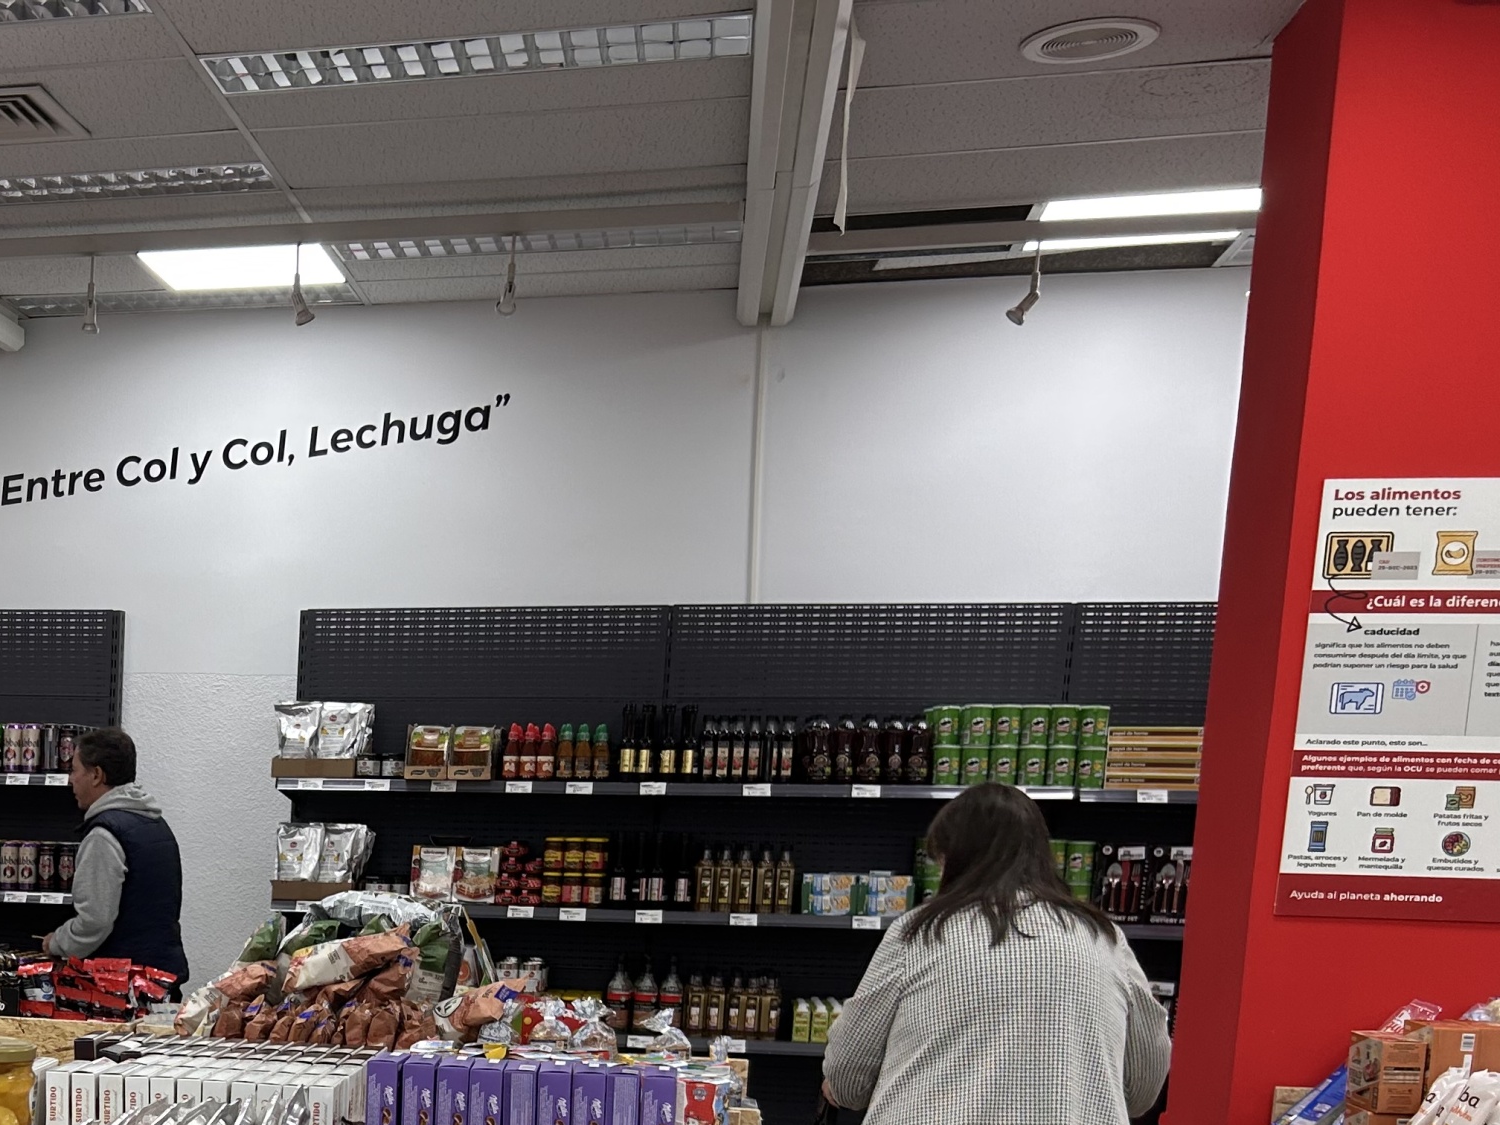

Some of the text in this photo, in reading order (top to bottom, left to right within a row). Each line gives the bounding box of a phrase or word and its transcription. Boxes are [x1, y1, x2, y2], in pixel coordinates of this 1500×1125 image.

[117, 447, 179, 486] Col
[187, 449, 212, 485] y
[222, 429, 295, 471] Col,
[1334, 488, 1461, 500] Los alimentos
[1332, 504, 1457, 519] pueden tener:
[1366, 596, 1405, 610] ¿Cuál
[1410, 599, 1425, 607] es
[1429, 596, 1442, 607] la
[1364, 627, 1420, 636] caducidad
[1358, 652, 1389, 661] después
[1339, 755, 1377, 763] ejemplos
[1301, 764, 1345, 772] preferente
[1367, 765, 1392, 773] según
[1437, 766, 1468, 774] pueden
[1290, 890, 1443, 903] Ayuda al planeta ahorrando
[49, 1086, 57, 1121] SURTIDO
[75, 1087, 83, 1123] SURTIDO
